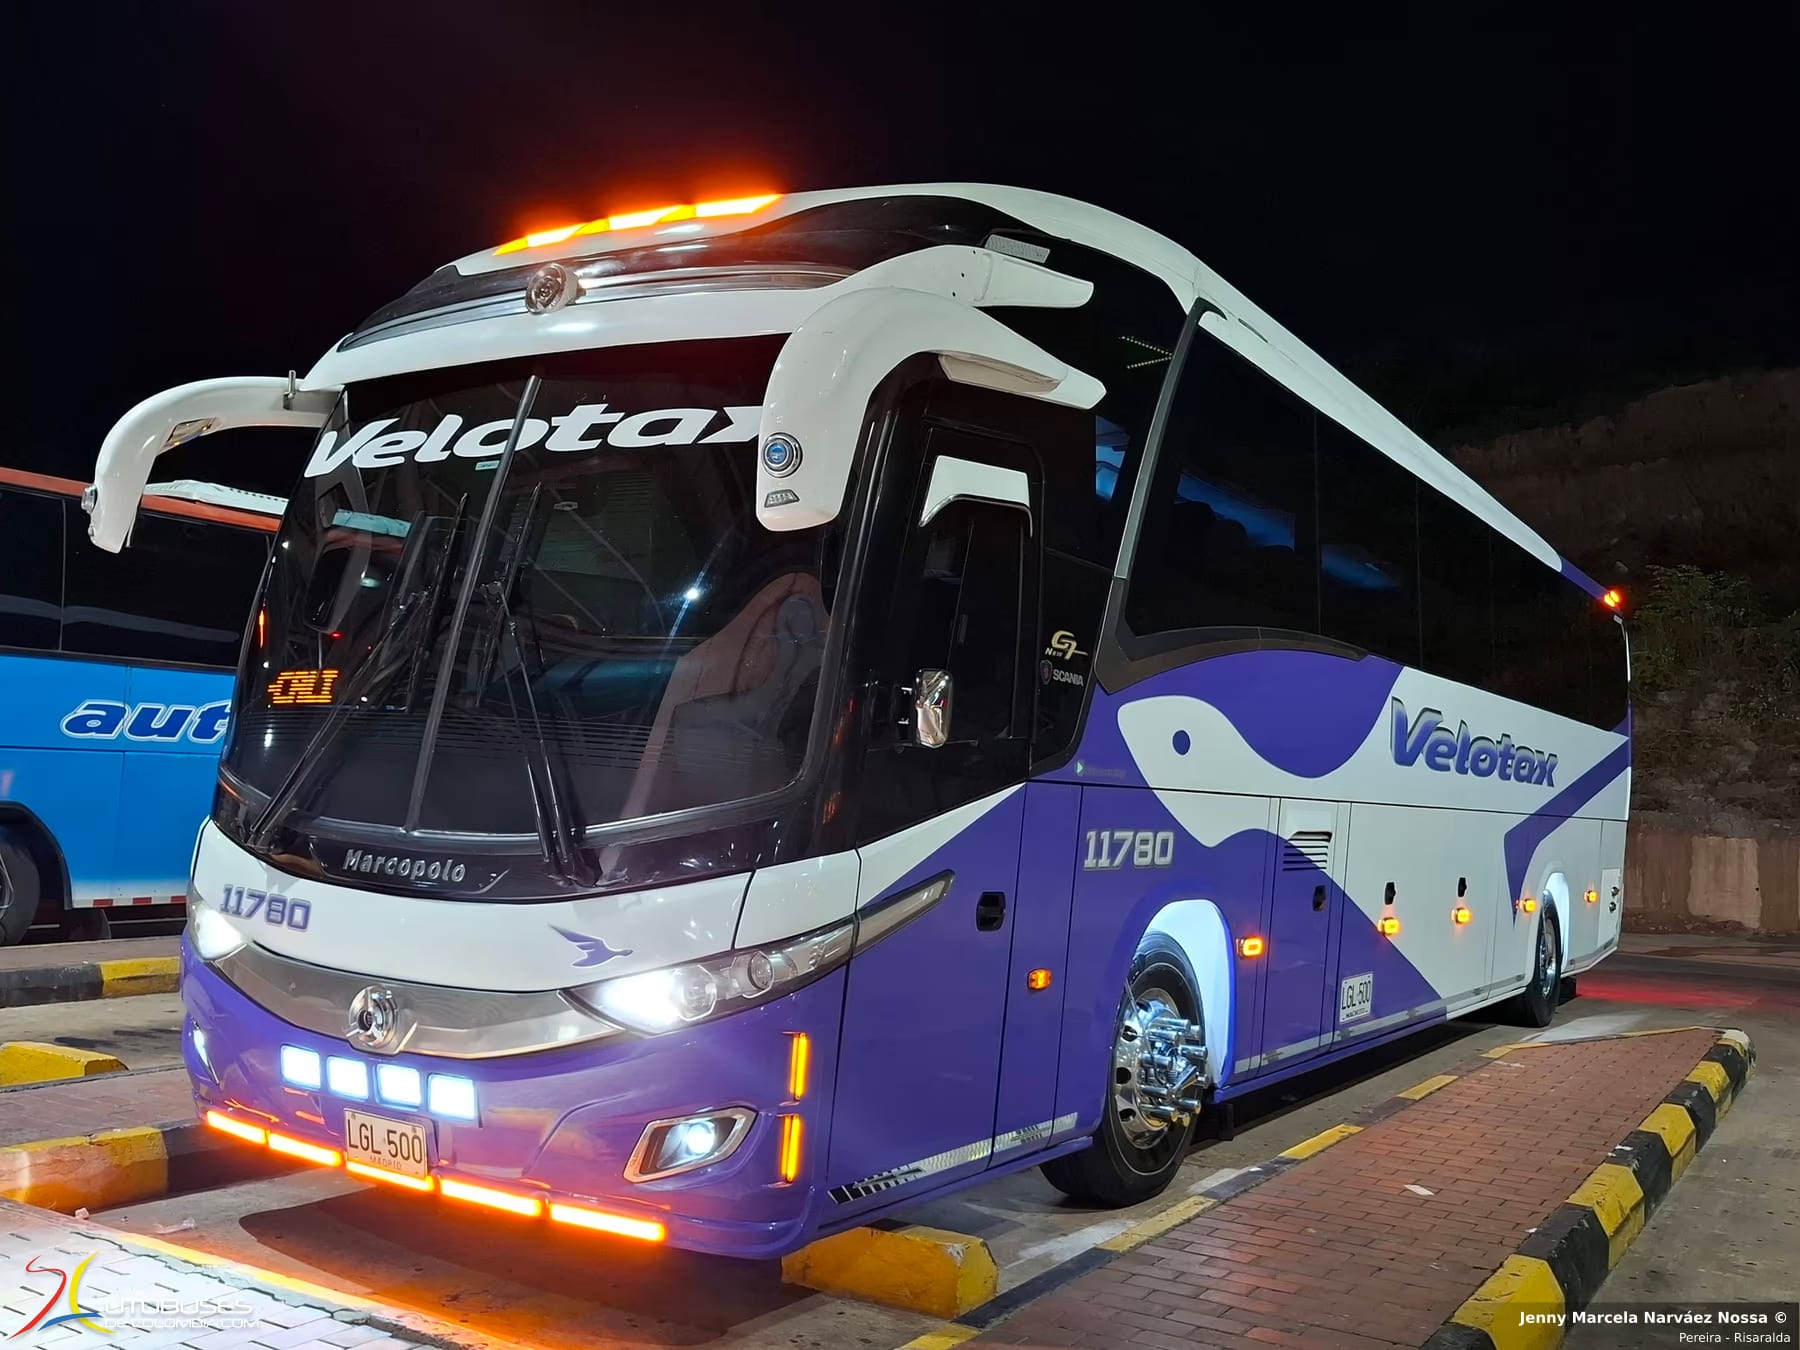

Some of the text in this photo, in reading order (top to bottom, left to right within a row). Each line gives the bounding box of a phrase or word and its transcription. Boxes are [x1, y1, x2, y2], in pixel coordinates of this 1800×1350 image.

[1052, 668, 1084, 686] SCANIA
[1390, 696, 1558, 787] Velotax
[342, 848, 467, 882] Marcopolo
[1084, 830, 1174, 869] 11780
[221, 884, 312, 930] 11780
[347, 1119, 423, 1164] LGL 500
[370, 1155, 402, 1170] MADRID
